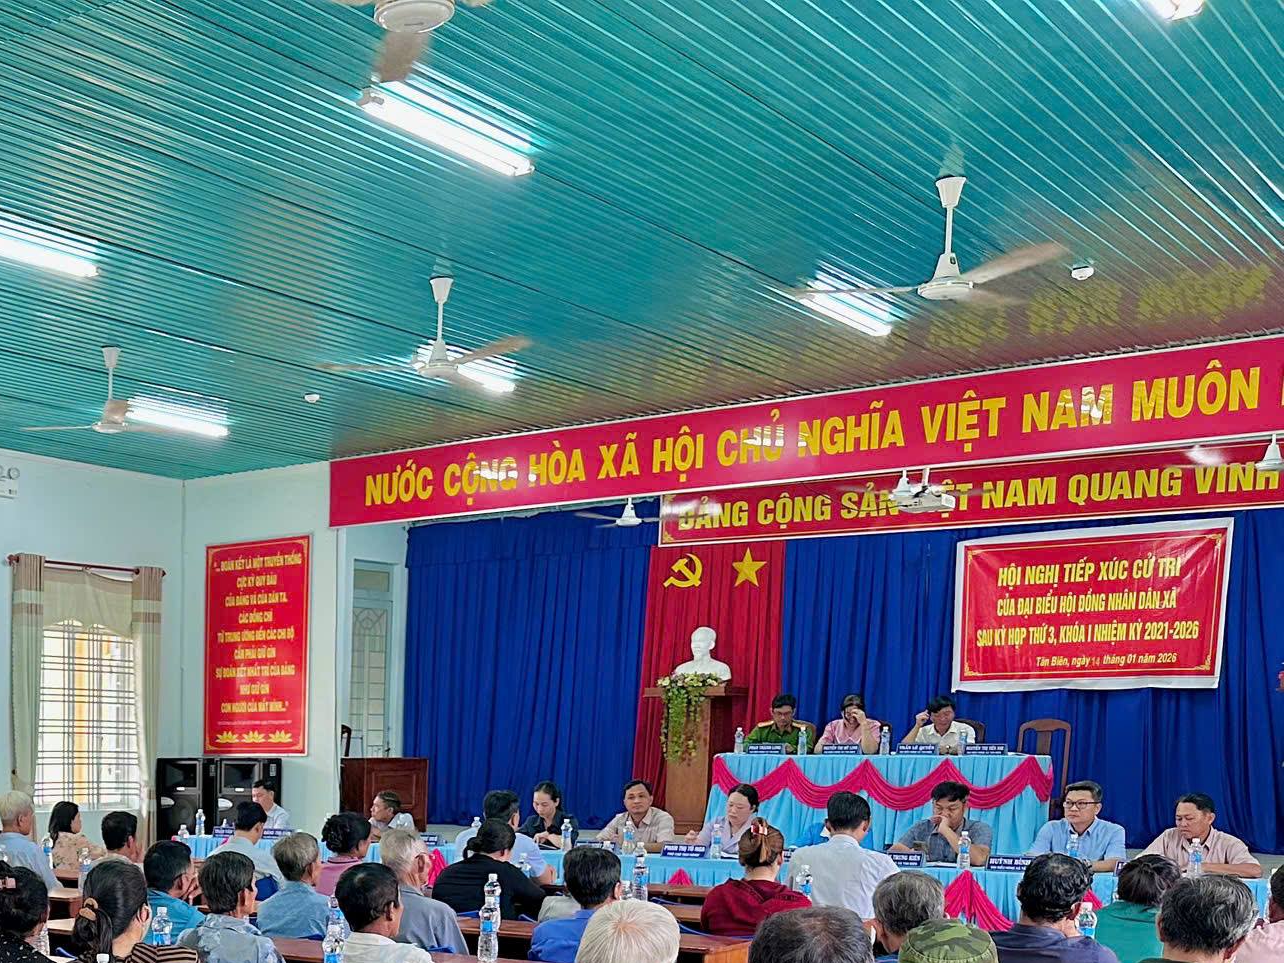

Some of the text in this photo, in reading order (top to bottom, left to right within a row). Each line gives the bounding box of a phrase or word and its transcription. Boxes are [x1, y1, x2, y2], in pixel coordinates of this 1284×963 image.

[365, 459, 434, 506] NƯỚC
[444, 452, 518, 505] CỘNG
[528, 440, 586, 487] HÒA
[597, 432, 640, 480] XÃ
[652, 425, 703, 482] HỘI
[717, 408, 785, 467] CHỦ
[798, 400, 905, 458] NGHĨA
[920, 389, 1006, 453] VIỆT
[1022, 384, 1113, 433] NAM
[1131, 359, 1260, 422] MUÔN
[757, 492, 832, 529] CỘNG
[841, 482, 899, 518] SẢN
[982, 477, 1056, 509] NAM
[1068, 467, 1183, 506] QUANG
[1194, 462, 1279, 494] VINH
[998, 552, 1181, 590] HỘI NGHỊ TIẾP XÚC CỬ TRI
[997, 593, 1015, 616] CỦA
[1017, 597, 1034, 619] ĐẠI
[1035, 589, 1057, 615] BIỂU
[1059, 592, 1076, 616] HỘI
[1108, 589, 1136, 611] NHÂN
[1138, 587, 1160, 610] DÂN
[1162, 587, 1177, 608] XÃ
[977, 629, 993, 647] SAU
[994, 624, 1006, 646] KỲ
[1008, 627, 1026, 649] HỌP
[1029, 622, 1048, 645] THỨ
[1048, 626, 1056, 646] 3,
[1059, 620, 1085, 643] KHÓA
[1087, 624, 1092, 642] I
[1094, 620, 1127, 645] NHIỆM
[1144, 621, 1199, 640] 2021-2026
[1071, 654, 1091, 667] ngày
[1103, 654, 1126, 666] tháng
[1127, 653, 1136, 664] 01
[1138, 653, 1155, 664] năm
[1157, 653, 1177, 663] 2026
